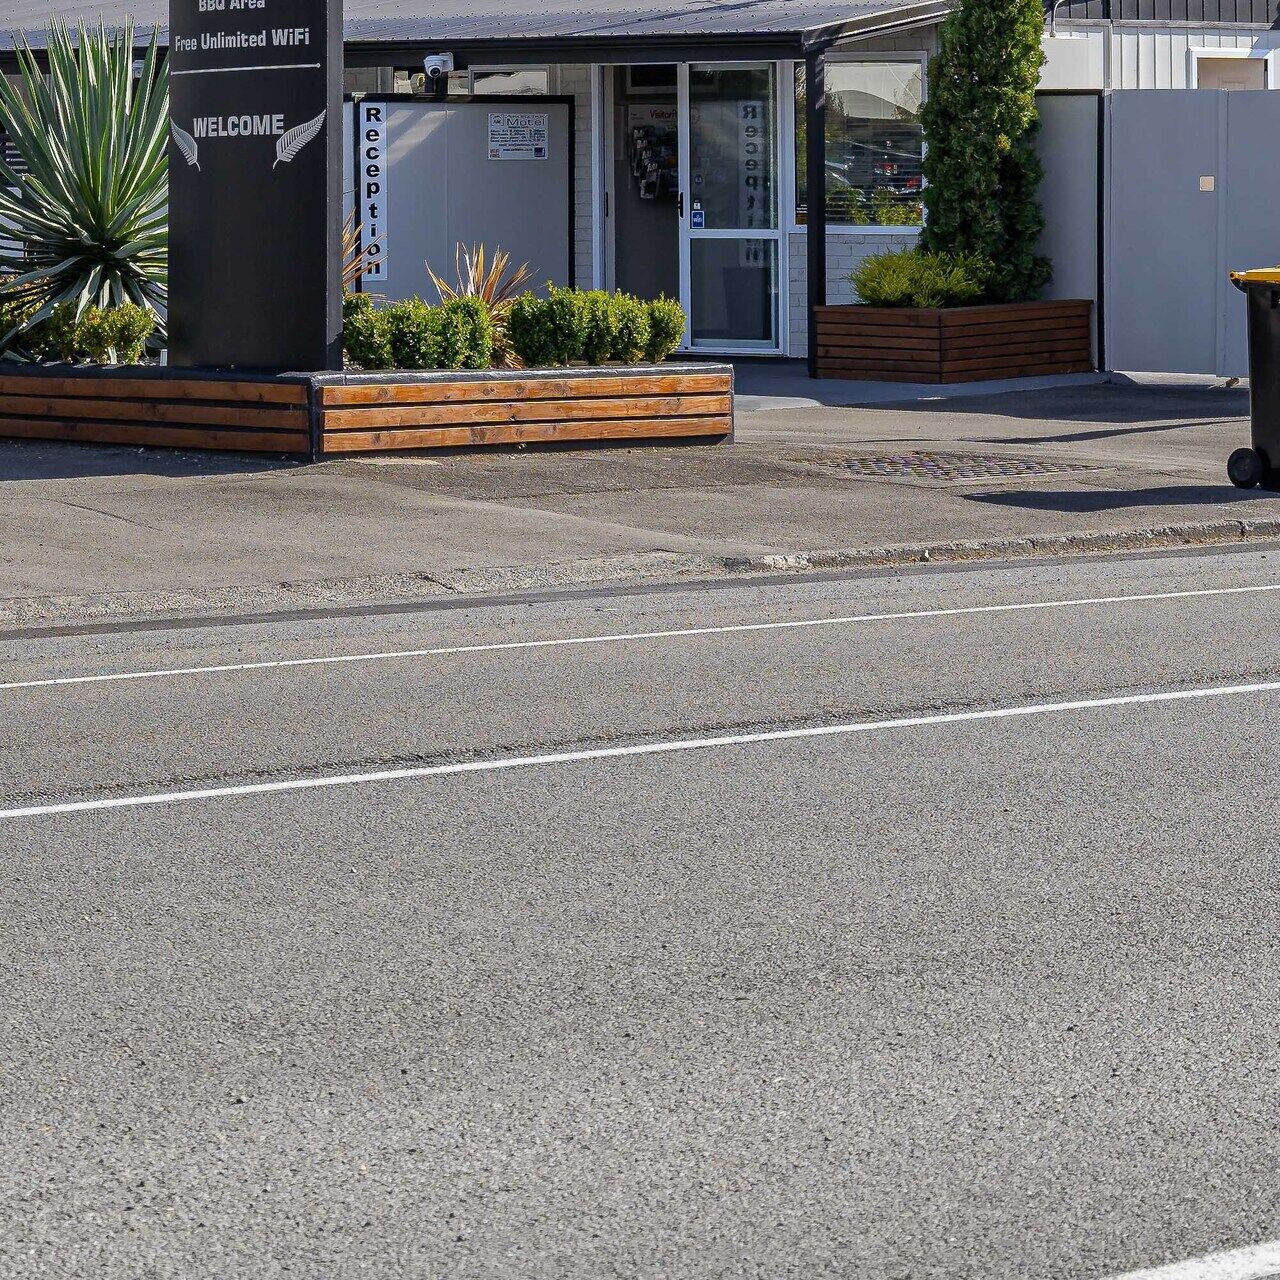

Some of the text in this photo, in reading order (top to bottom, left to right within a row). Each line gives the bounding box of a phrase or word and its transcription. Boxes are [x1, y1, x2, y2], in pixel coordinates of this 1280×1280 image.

[175, 28, 310, 51] Free Unlimited WiFi
[193, 114, 285, 138] WELCOME
[365, 107, 382, 275] Reception
